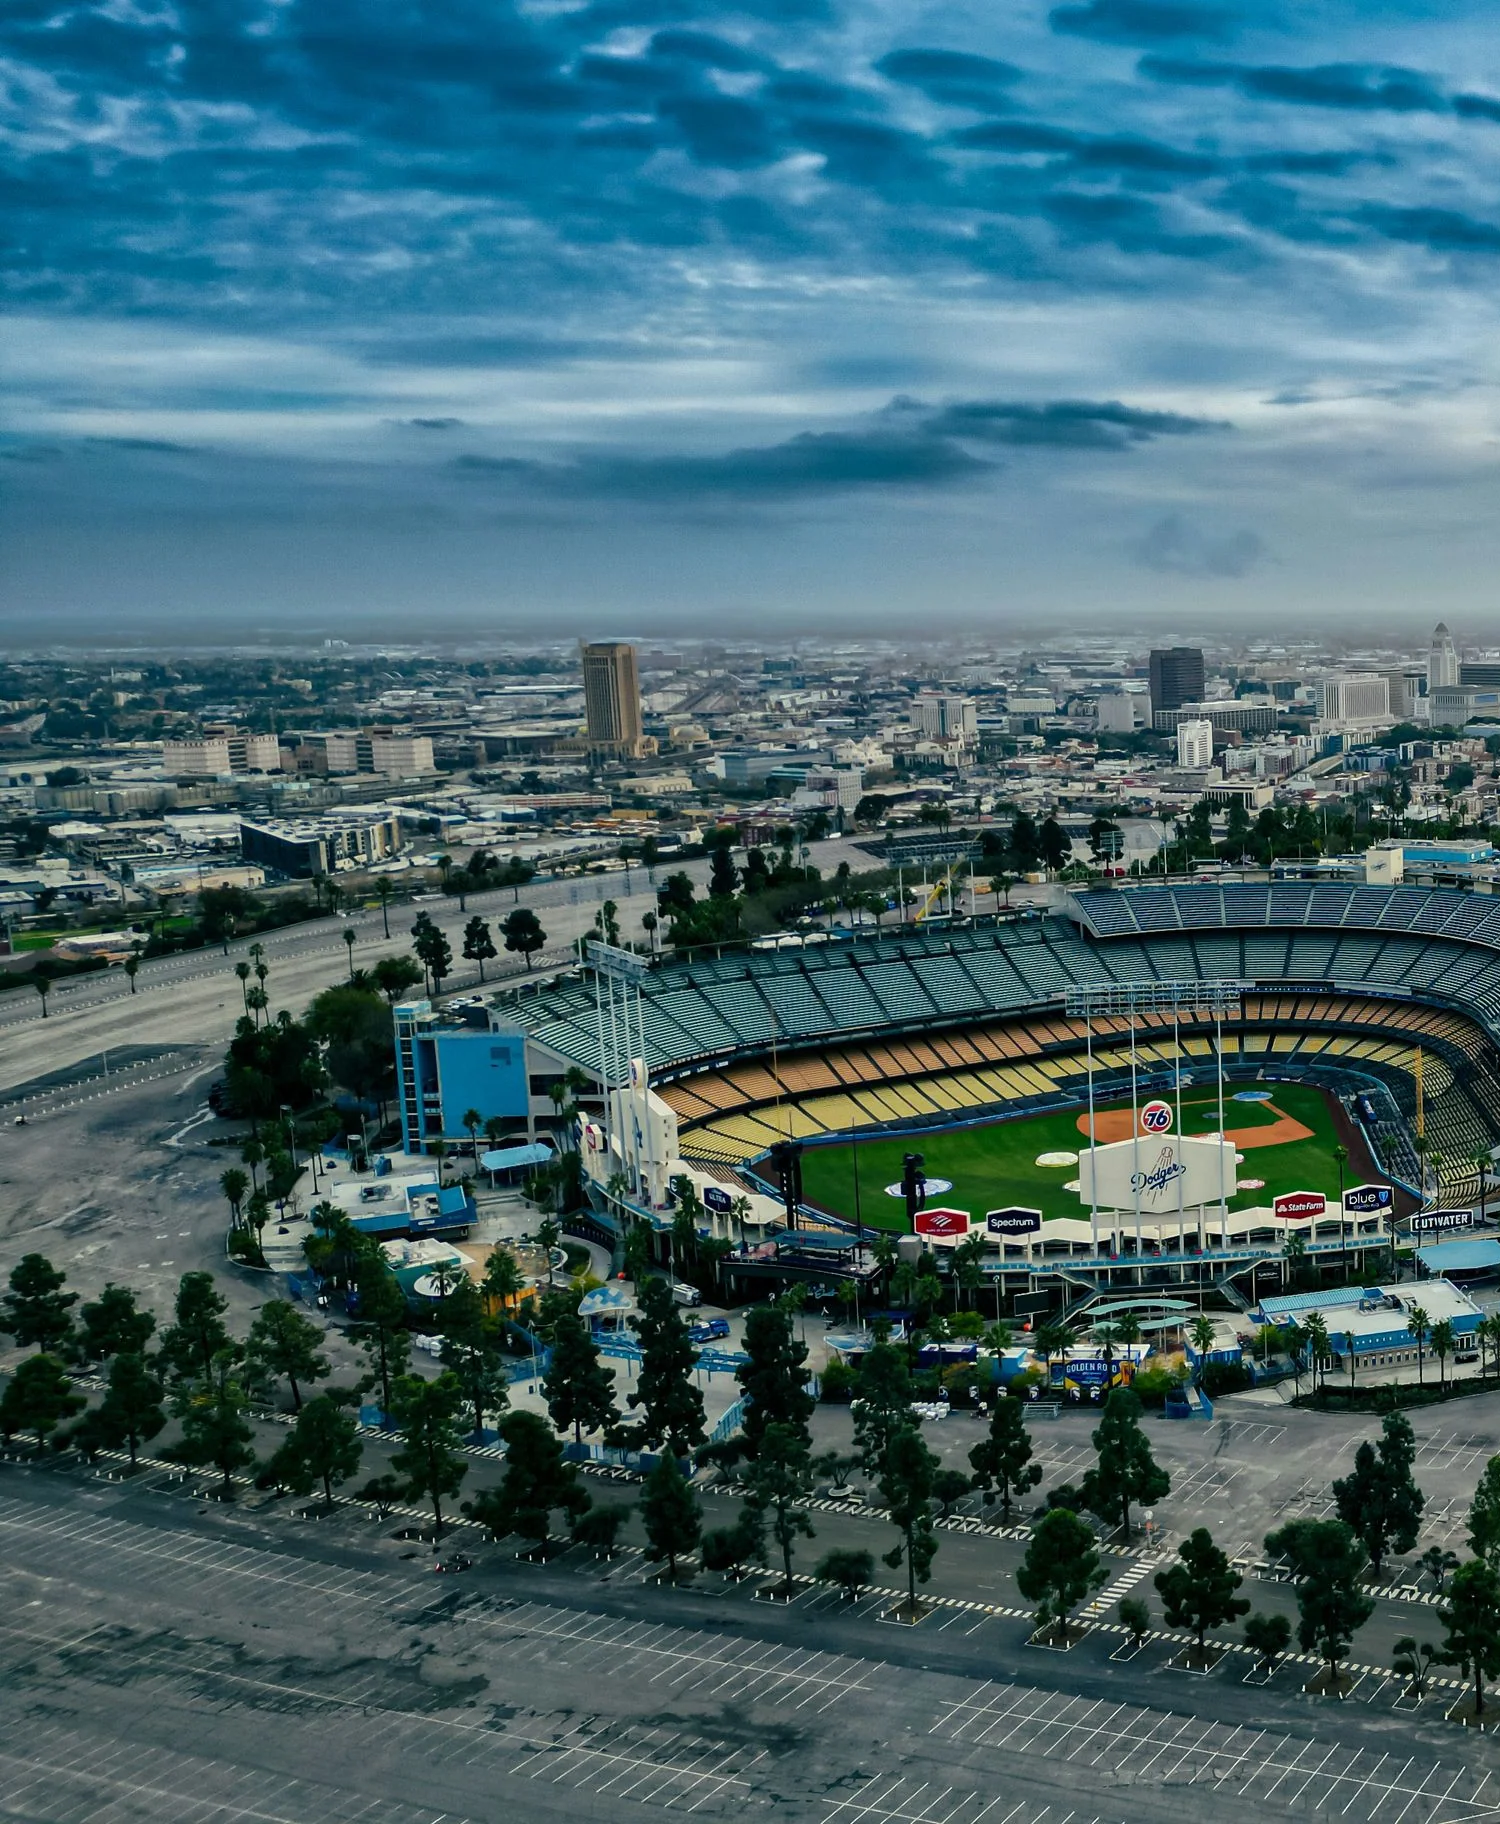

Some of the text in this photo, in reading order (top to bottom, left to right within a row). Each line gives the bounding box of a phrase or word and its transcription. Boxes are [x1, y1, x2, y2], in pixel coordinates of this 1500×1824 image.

[1146, 1109, 1170, 1128] 76
[1131, 1162, 1186, 1193] Dodgers
[1349, 1192, 1376, 1205] blue
[991, 1218, 1034, 1229] Spectrum
[1066, 1362, 1117, 1373] GOLDEN ROD
